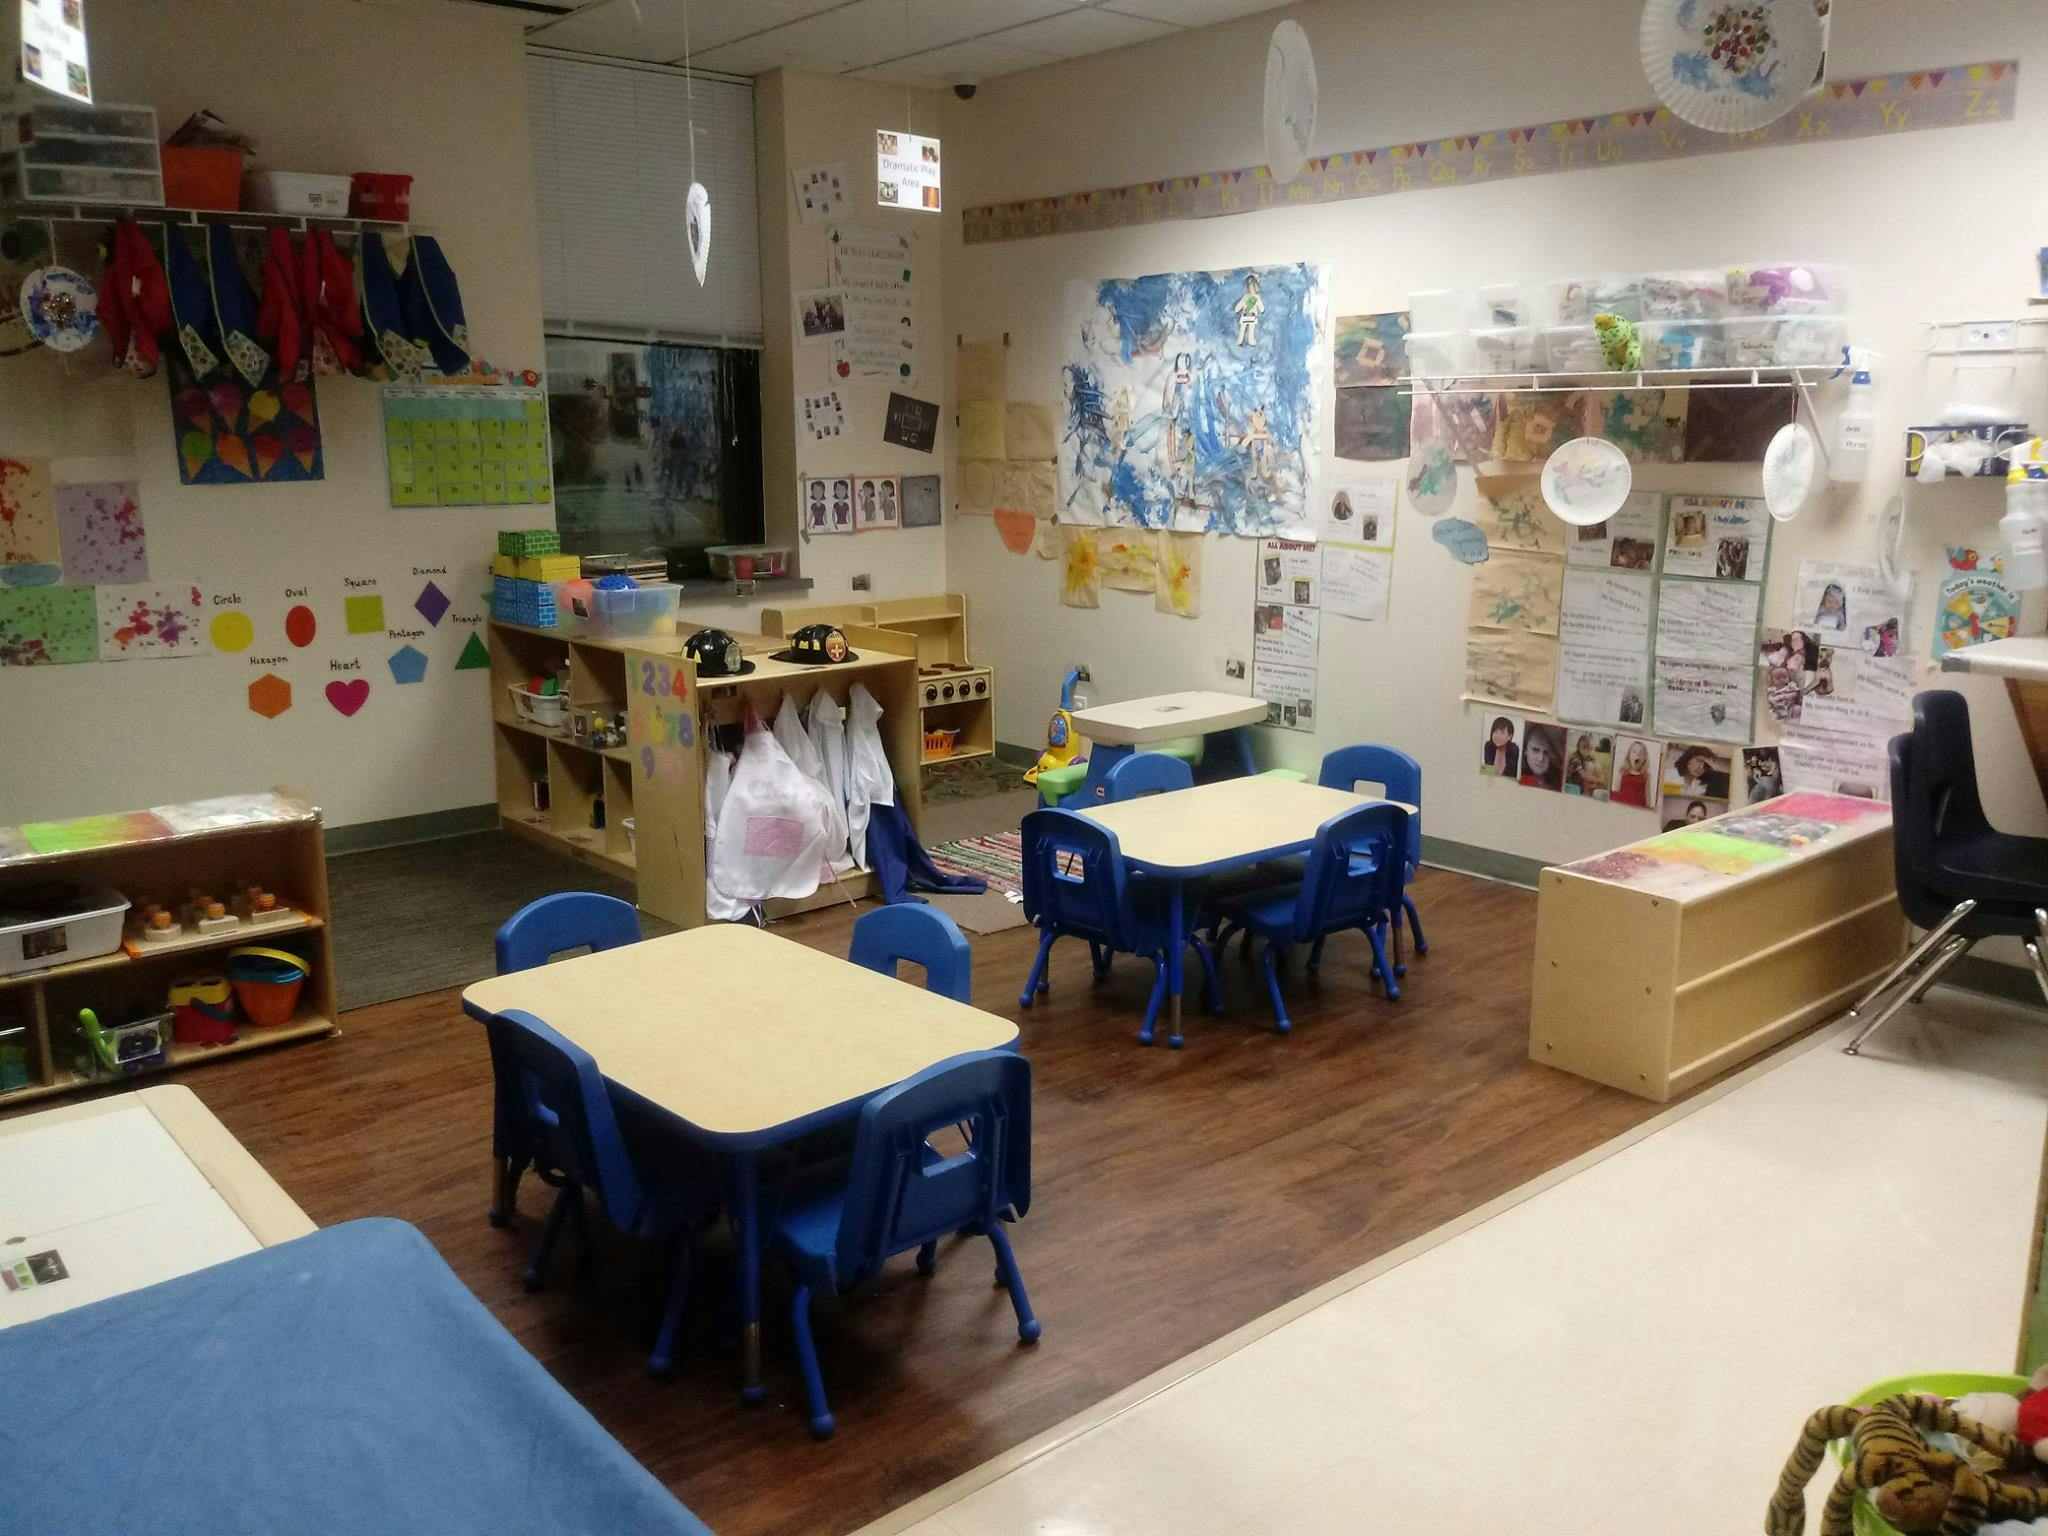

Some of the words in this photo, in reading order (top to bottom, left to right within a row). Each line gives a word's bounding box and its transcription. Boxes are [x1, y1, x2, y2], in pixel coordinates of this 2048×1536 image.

[1798, 112, 1830, 136] Xx
[1880, 100, 1909, 132] Yy
[882, 158, 920, 175] Dramatic
[920, 162, 937, 178] Play
[902, 177, 921, 189] Area
[412, 566, 448, 576] Diamond
[344, 577, 377, 589] Square
[1976, 579, 2008, 593] weather
[285, 587, 309, 598] Oval
[213, 594, 242, 606] Circle
[452, 613, 483, 625] Triangle
[389, 629, 426, 641] Pentagon
[249, 655, 289, 667] Hexagon
[329, 659, 362, 671] Heart
